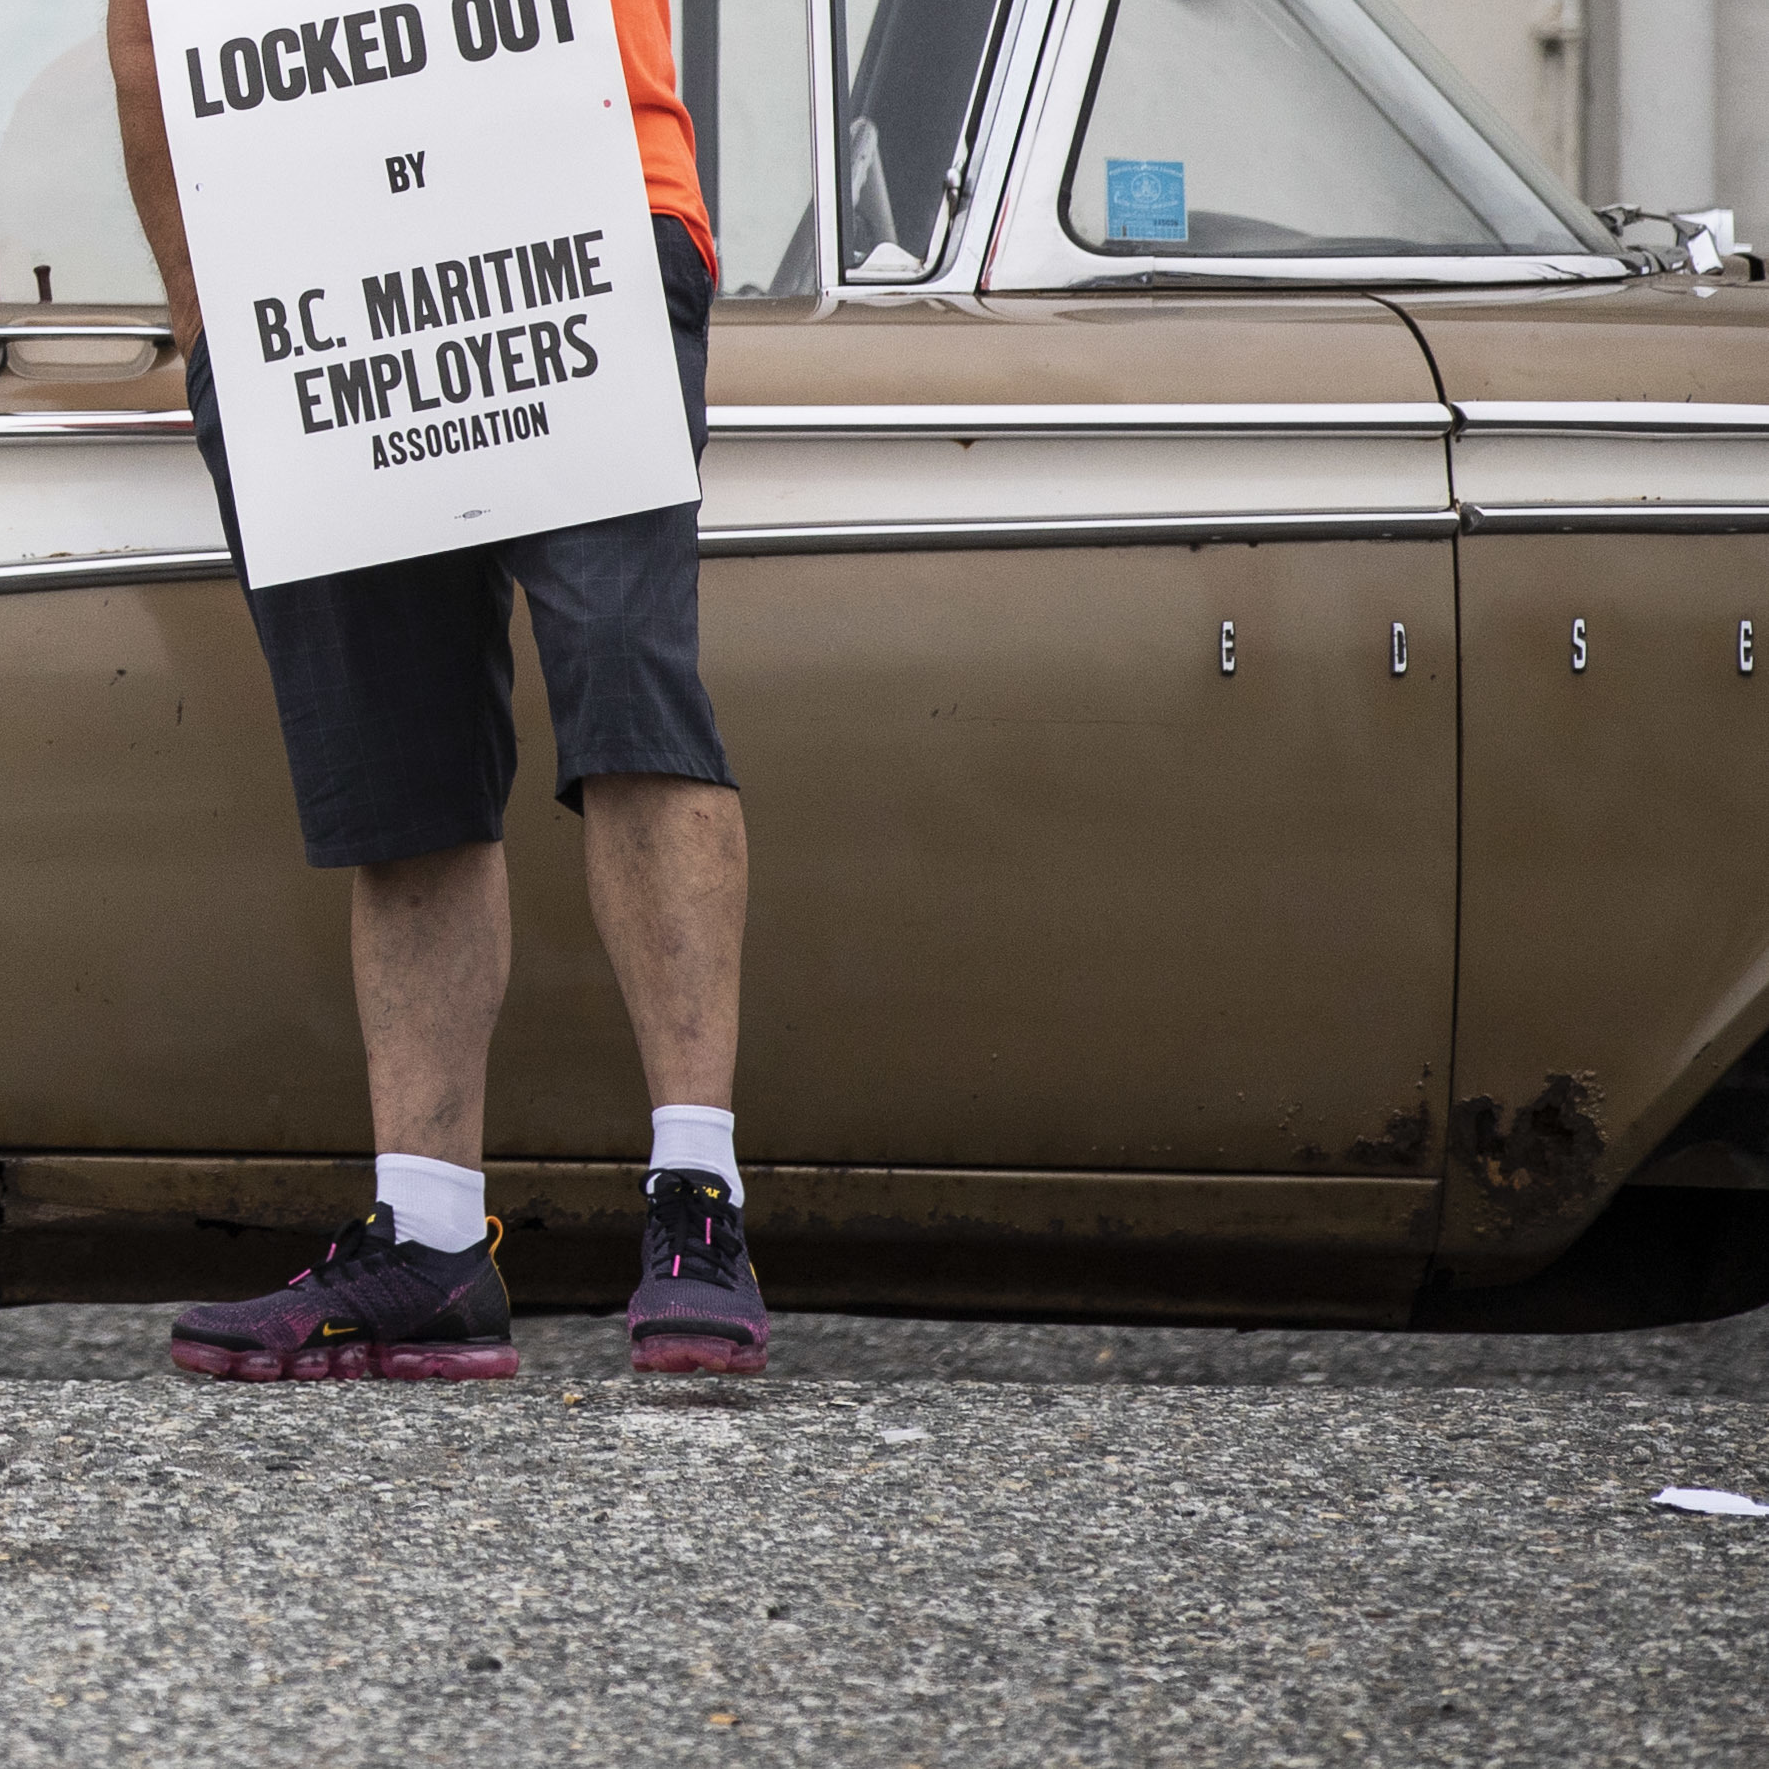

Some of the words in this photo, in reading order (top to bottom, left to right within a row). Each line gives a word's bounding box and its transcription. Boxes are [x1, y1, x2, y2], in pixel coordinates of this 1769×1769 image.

[185, 3, 427, 119] LOCKED
[385, 150, 425, 194] BY
[253, 288, 347, 363] B.C.
[361, 229, 613, 341] MARITIME
[293, 313, 599, 435] EMPLOYERS
[372, 401, 550, 470] ASSOCIATION
